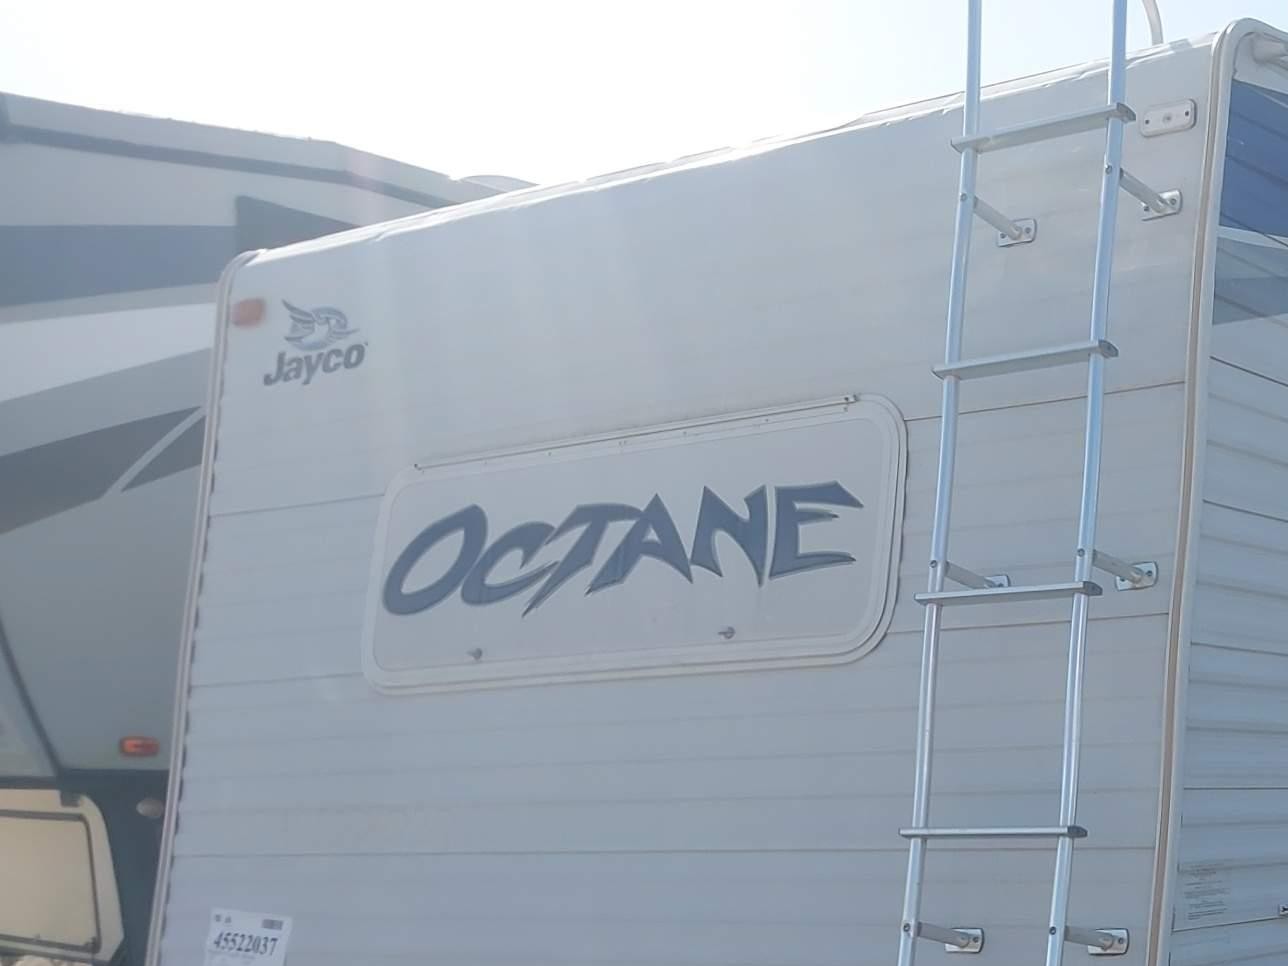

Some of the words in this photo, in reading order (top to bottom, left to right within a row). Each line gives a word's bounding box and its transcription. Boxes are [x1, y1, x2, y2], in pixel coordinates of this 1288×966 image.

[263, 343, 366, 386] Jayco
[382, 480, 864, 618] OCTANE
[213, 932, 279, 956] 45522037
